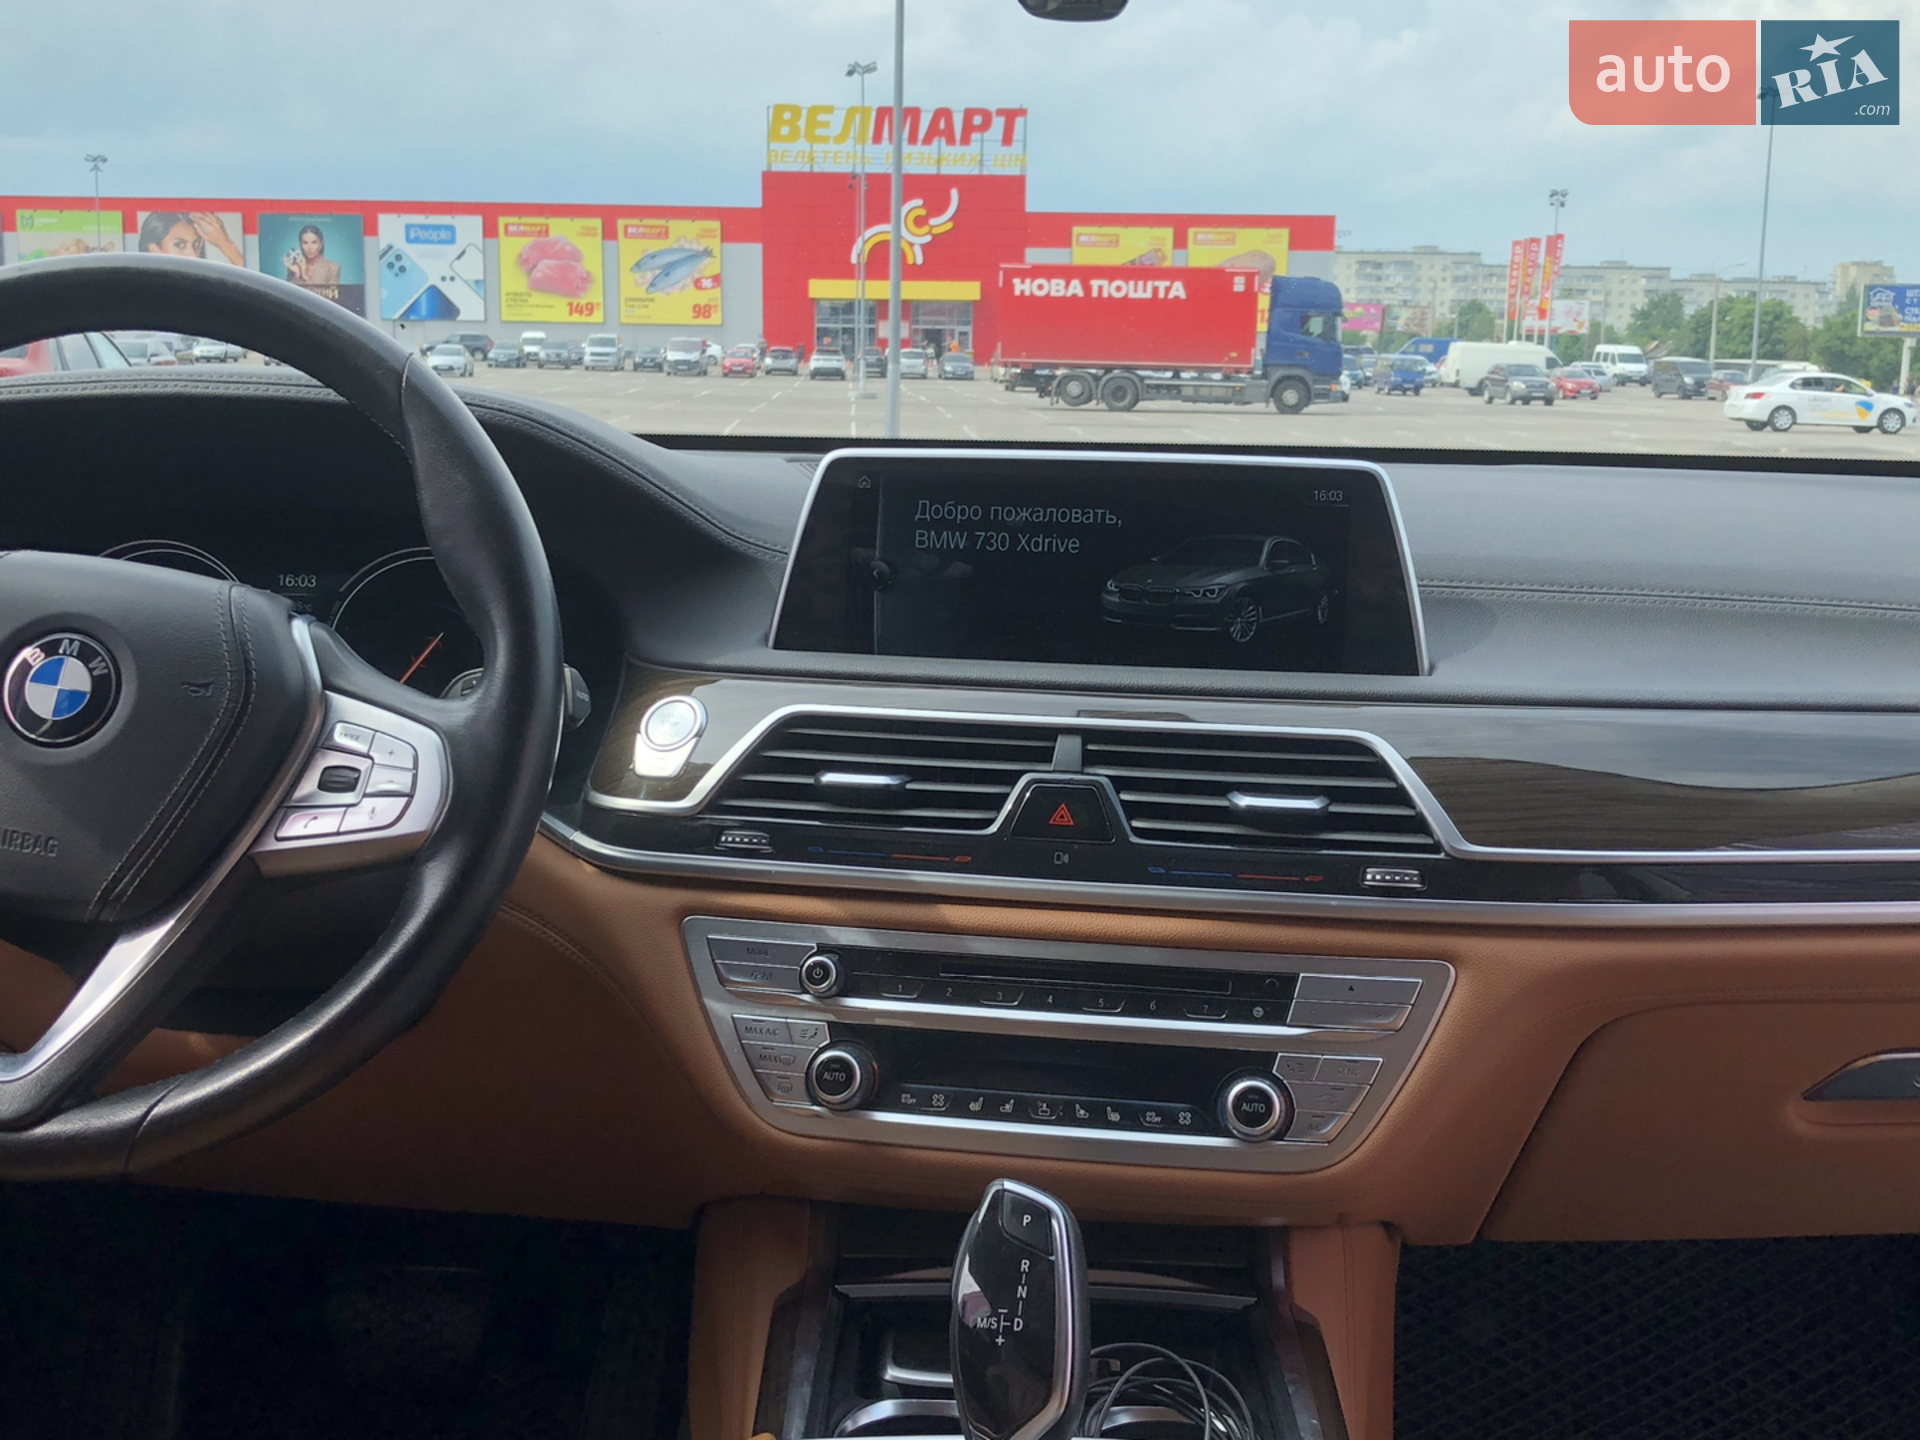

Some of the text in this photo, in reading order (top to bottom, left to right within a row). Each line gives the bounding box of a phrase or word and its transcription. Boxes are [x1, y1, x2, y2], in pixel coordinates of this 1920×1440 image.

[768, 103, 1028, 147] ВЕЛМАРТ
[409, 227, 452, 242] iPeople
[1012, 278, 1187, 300] НОВА ПОШТА
[566, 301, 595, 317] 149
[692, 303, 712, 320] 98
[1313, 488, 1344, 503] 16:03
[914, 499, 1123, 528] Добро пожаловать,
[914, 529, 1081, 554] BMW 730 Xdrive
[278, 573, 318, 589] 16:03
[25, 638, 109, 677] BMW
[0, 827, 58, 858] IRBAG
[946, 987, 952, 997] 2
[997, 991, 1003, 1001] 3
[1047, 994, 1053, 1004] 4
[1099, 998, 1104, 1008] 5
[1150, 1001, 1156, 1011] 6
[744, 1025, 764, 1036] MAX
[759, 1053, 778, 1064] MAX
[823, 1071, 846, 1083] AUTO
[1241, 1102, 1266, 1114] AUTO
[1022, 1214, 1032, 1228] P
[1021, 1259, 1031, 1274] R
[1017, 1285, 1028, 1299] N
[976, 1316, 1024, 1332] M/S D
